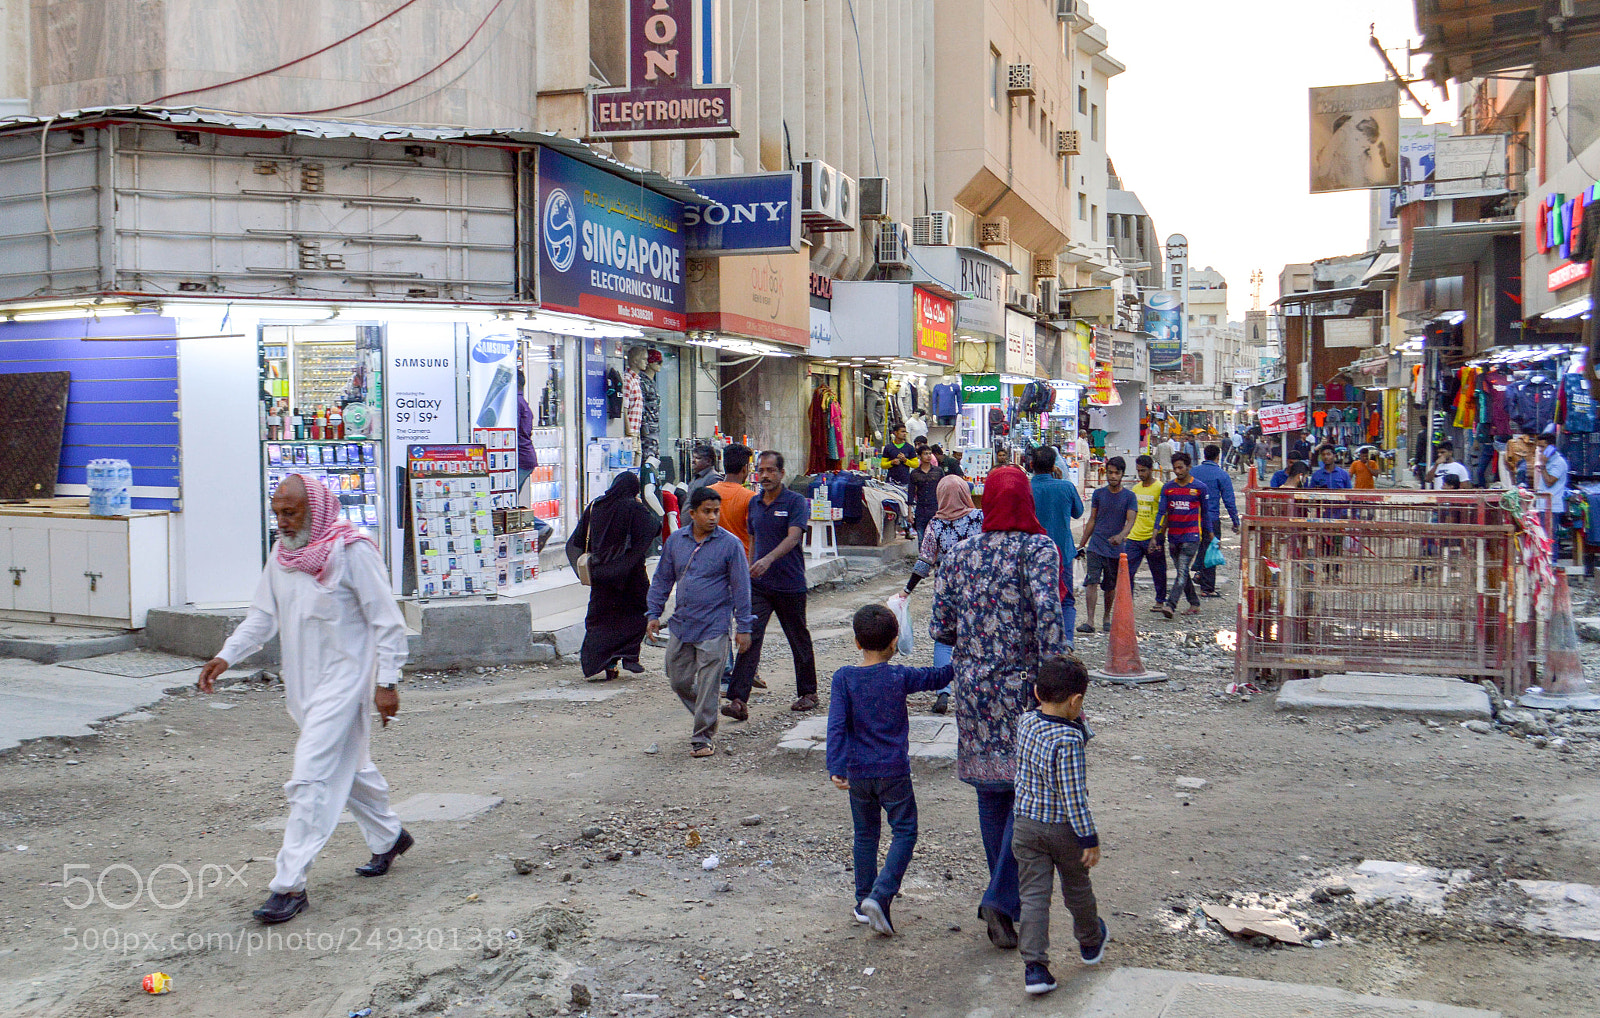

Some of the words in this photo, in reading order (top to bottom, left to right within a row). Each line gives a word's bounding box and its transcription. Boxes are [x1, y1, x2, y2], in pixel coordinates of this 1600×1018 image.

[600, 97, 724, 123] ELECTRONICS
[684, 201, 788, 226] SONY
[582, 220, 680, 284] SINGAPORE
[590, 269, 651, 299] ELECTORNICS
[961, 257, 992, 301] BASHA
[475, 341, 512, 355] SAMSUNG
[395, 358, 449, 368] SAMSUNG
[395, 397, 442, 411] Galaxy
[1260, 407, 1271, 418] FOR
[1271, 406, 1285, 415] SALE
[396, 412, 411, 423] S9
[418, 412, 438, 423] S9+
